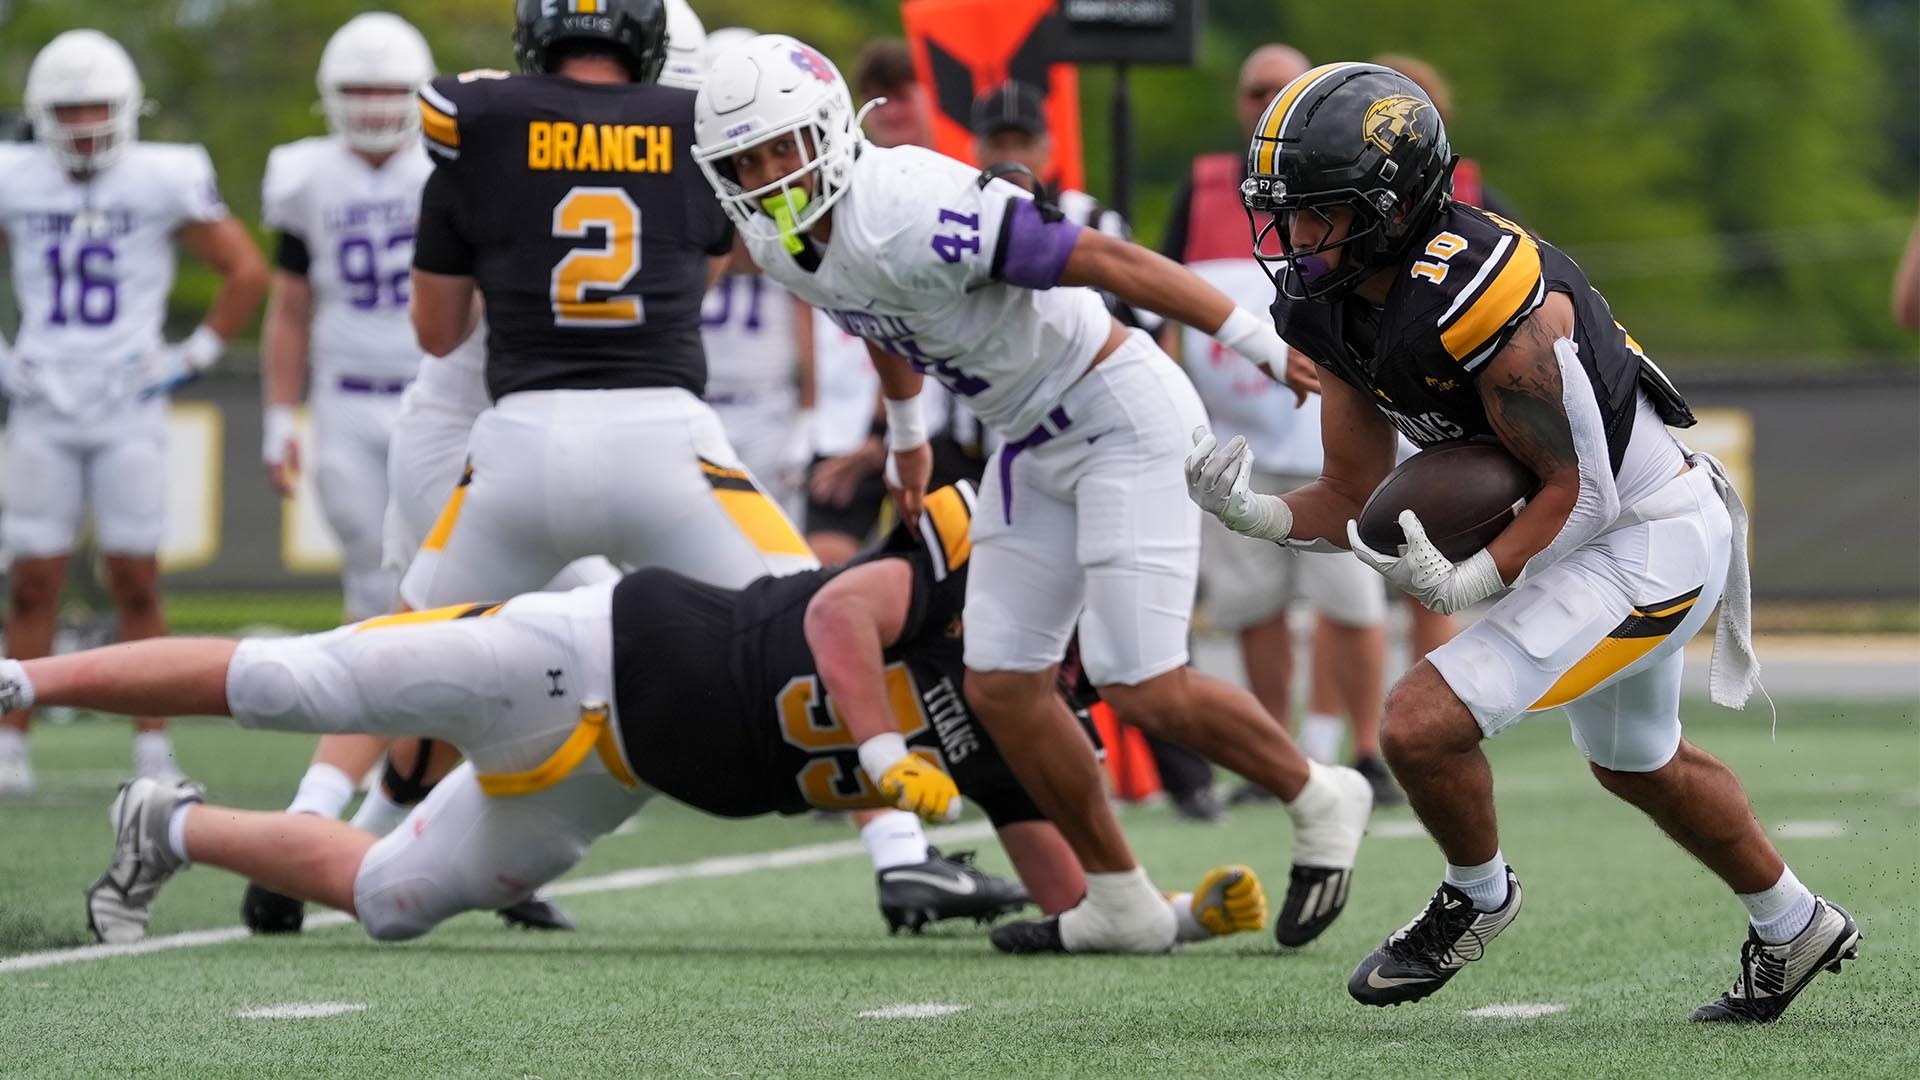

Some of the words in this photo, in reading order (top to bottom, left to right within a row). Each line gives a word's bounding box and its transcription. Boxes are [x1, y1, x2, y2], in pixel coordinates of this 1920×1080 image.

[528, 121, 672, 173] BRANCH
[1260, 180, 1270, 190] F7
[551, 186, 646, 327] 2
[931, 208, 980, 263] 41
[1411, 231, 1468, 285] 10
[46, 240, 116, 326] 16
[339, 230, 416, 310] 92
[922, 676, 980, 765] TITANS
